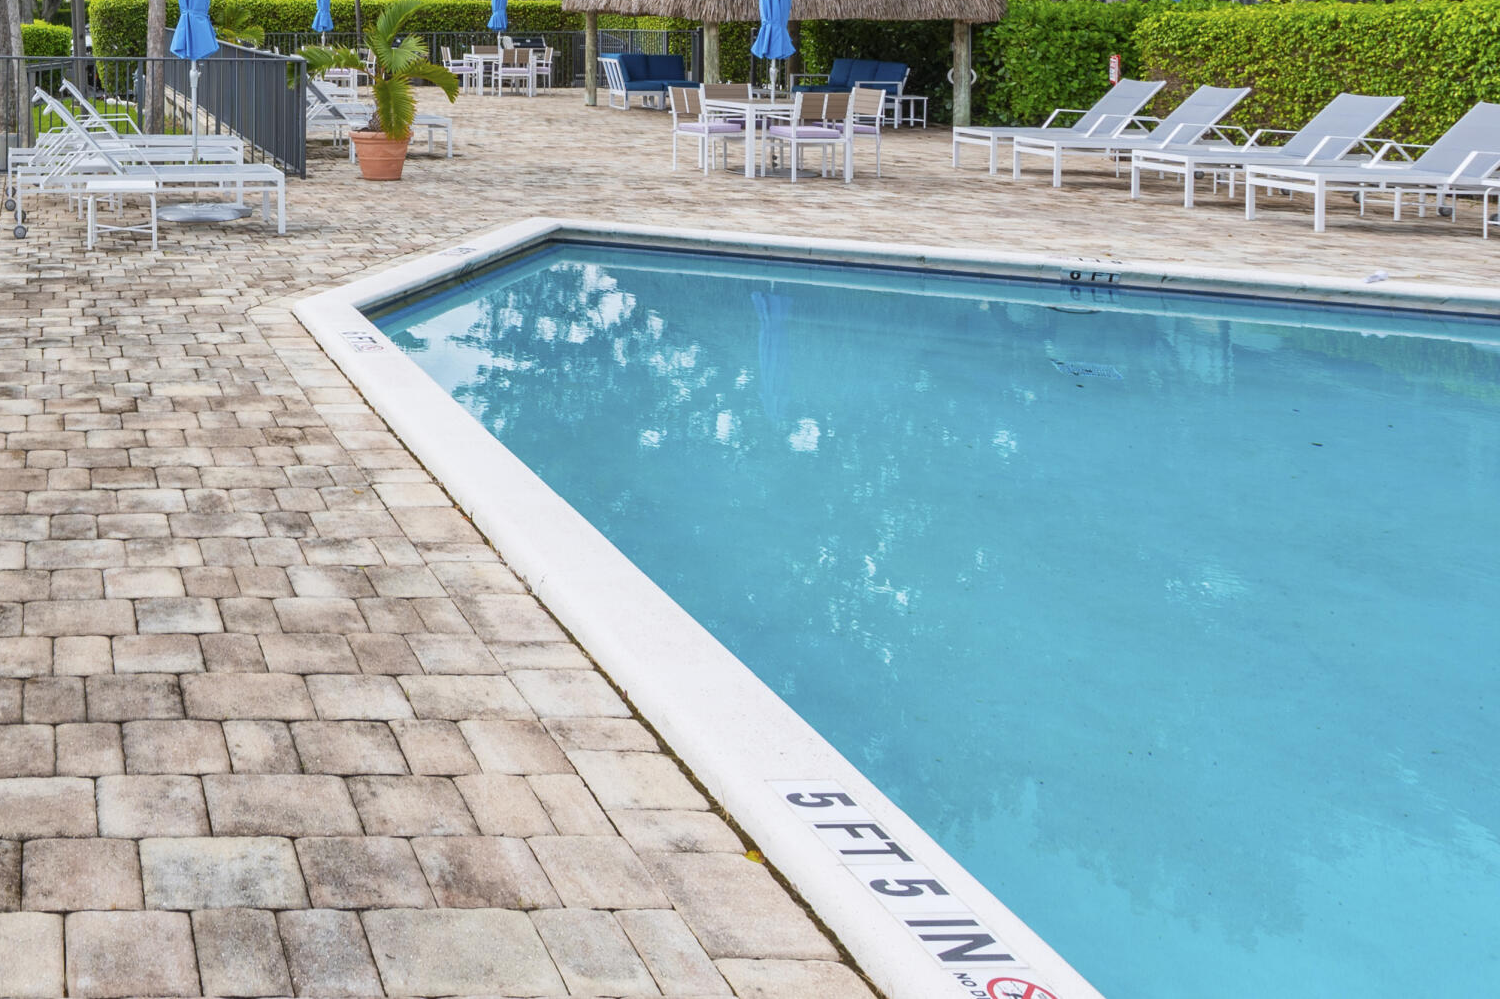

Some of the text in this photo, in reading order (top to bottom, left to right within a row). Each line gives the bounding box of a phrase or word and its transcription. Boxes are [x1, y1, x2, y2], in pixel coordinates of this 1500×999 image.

[1069, 270, 1120, 283] 6 FT
[785, 792, 1016, 962] 5 FT 5 IN
[953, 972, 977, 987] NO
